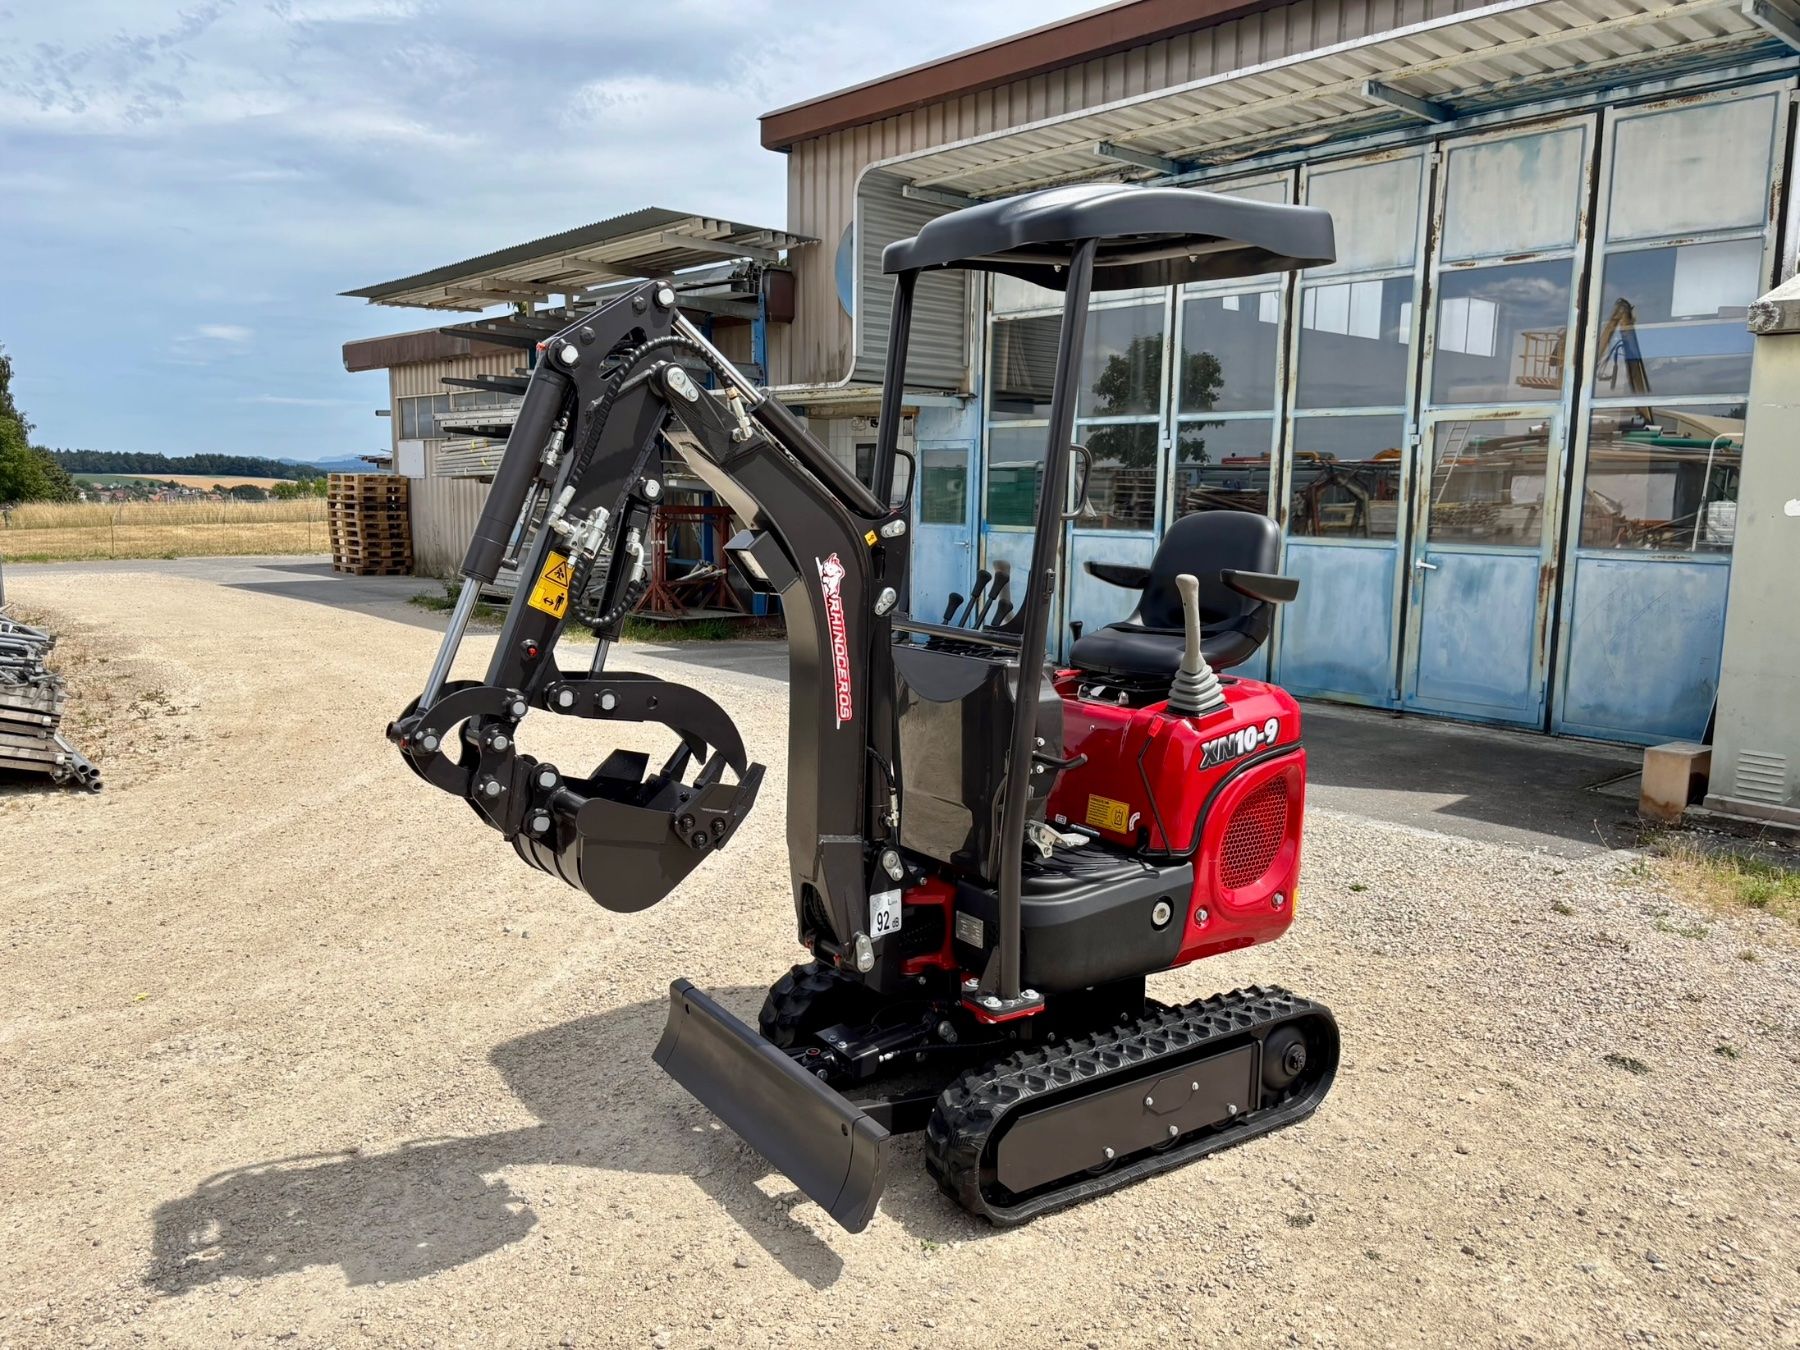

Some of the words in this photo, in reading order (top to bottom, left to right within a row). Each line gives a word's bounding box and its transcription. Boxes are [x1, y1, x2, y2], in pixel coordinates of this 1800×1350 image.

[829, 598, 851, 720] RHINOCEROS
[1199, 718, 1279, 769] XN10-9
[877, 910, 890, 931] 92
[891, 917, 900, 928] dB
